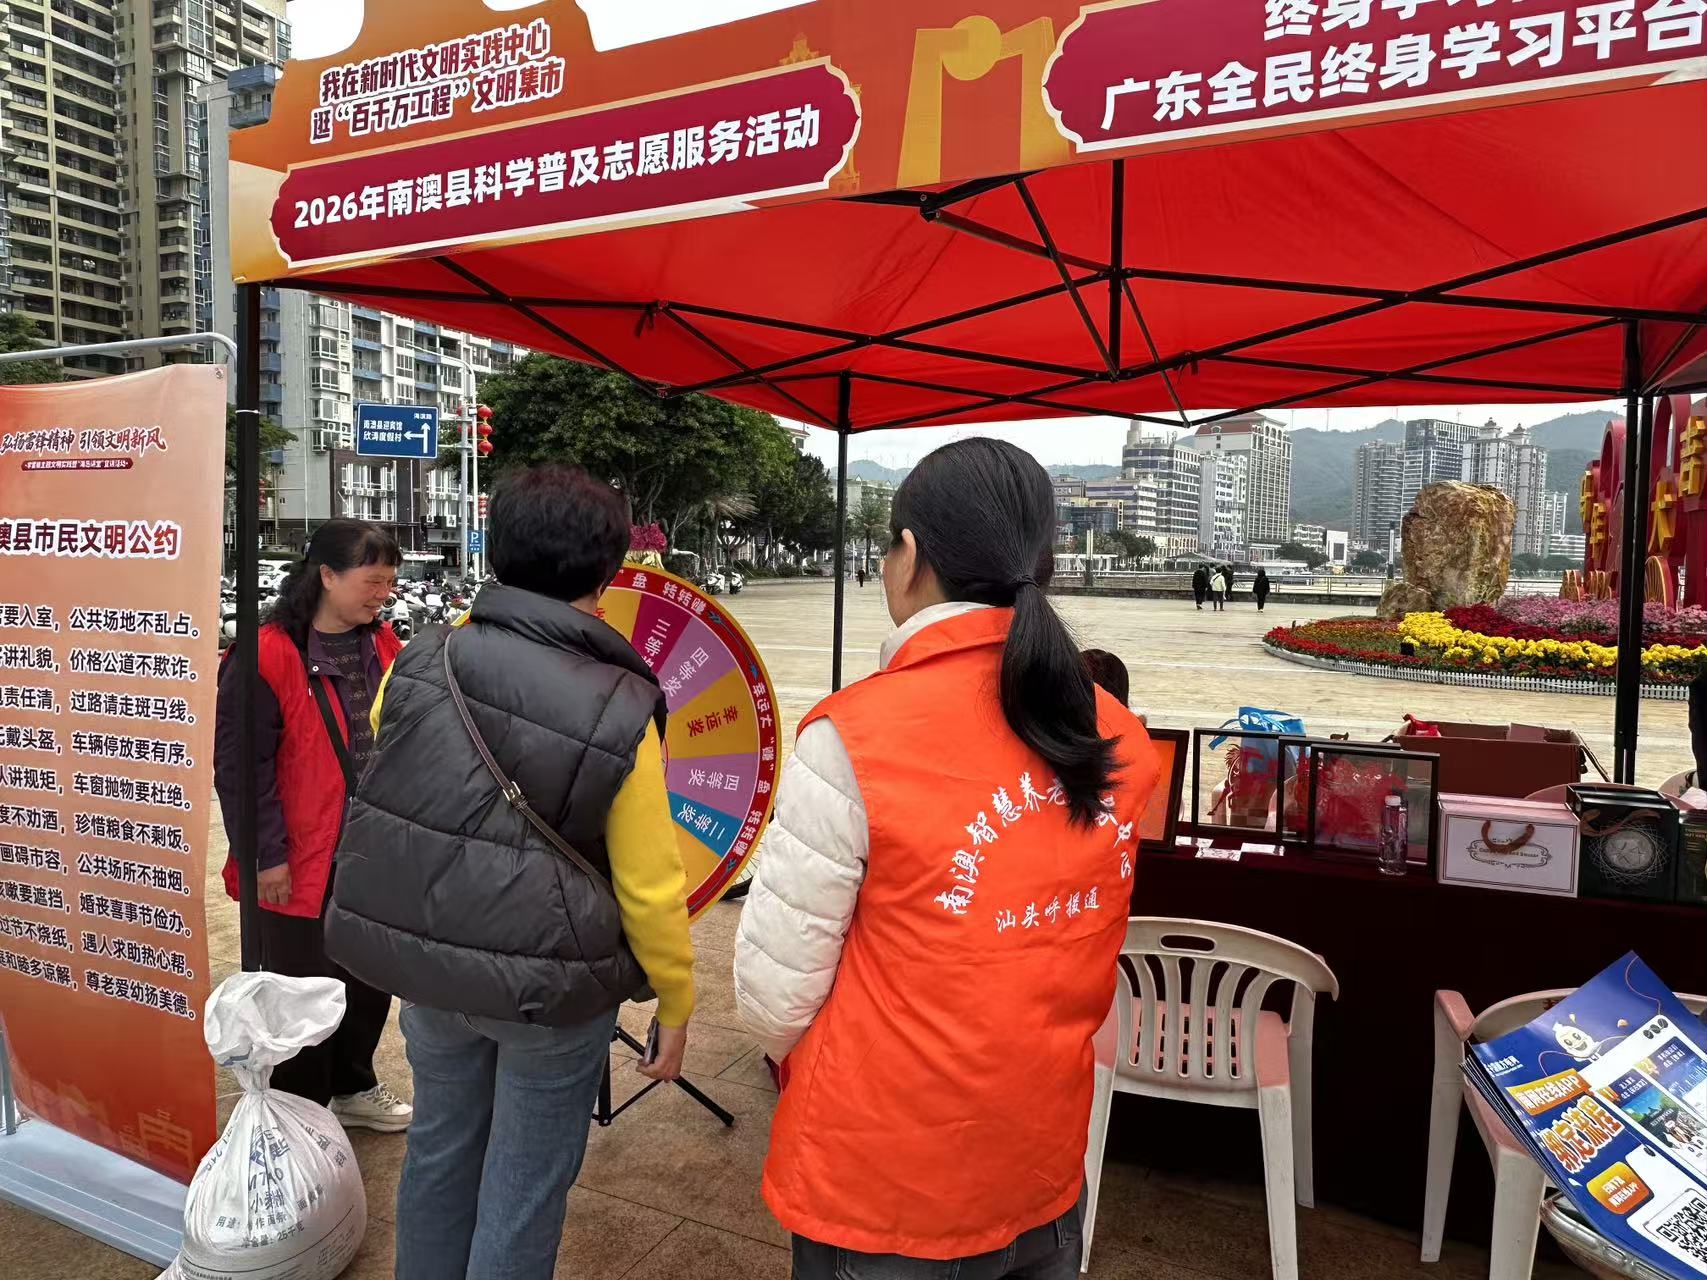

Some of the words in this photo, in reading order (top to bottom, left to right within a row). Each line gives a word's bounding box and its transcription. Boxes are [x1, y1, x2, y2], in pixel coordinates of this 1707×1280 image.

[321, 21, 548, 102] 我在新时代文明实践中心
[1100, 0, 1707, 131] 广东全民终身学习平台
[312, 60, 562, 140] 逛“百千万工程”文明集市
[294, 103, 822, 229] 2026年南澳县科学普及志愿服务活动
[1, 429, 75, 455] 弘扬雷锋精神
[79, 427, 167, 456] 引领文明新风
[0, 605, 199, 637] 要入室，公共场地不乱占。
[0, 647, 197, 680] 讲礼貌，价格公道不欺诈。
[662, 646, 709, 697] 四等奖
[0, 688, 195, 724] 责任清，过路请走斑马线。
[687, 705, 738, 738] 幸运奖
[687, 768, 740, 791] 四等奖
[677, 802, 725, 840] 二等奖
